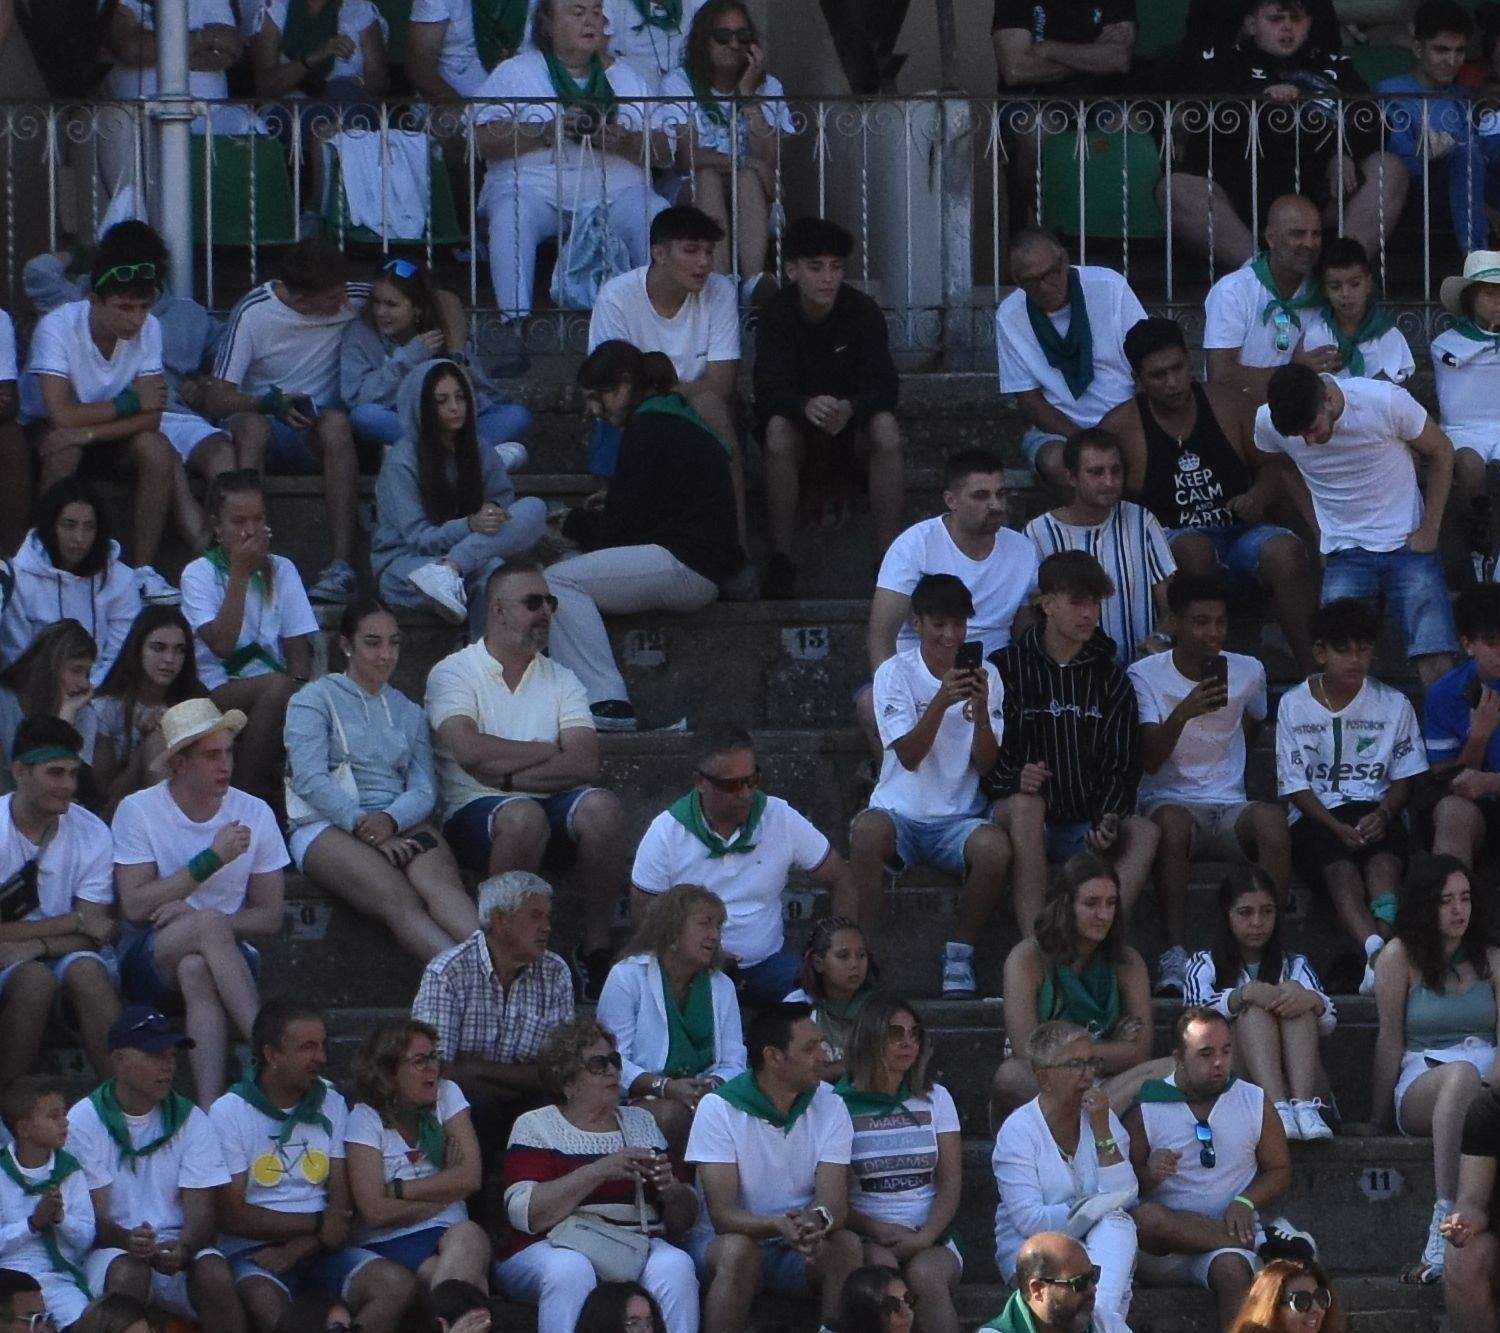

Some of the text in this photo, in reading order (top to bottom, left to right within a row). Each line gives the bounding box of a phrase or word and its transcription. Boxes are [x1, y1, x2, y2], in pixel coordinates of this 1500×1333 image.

[1173, 468, 1214, 489] KEEP
[1174, 483, 1224, 506] CALM
[869, 1115, 912, 1129] MAKE
[863, 1158, 932, 1173] DREAMS
[1366, 1171, 1392, 1192] 11
